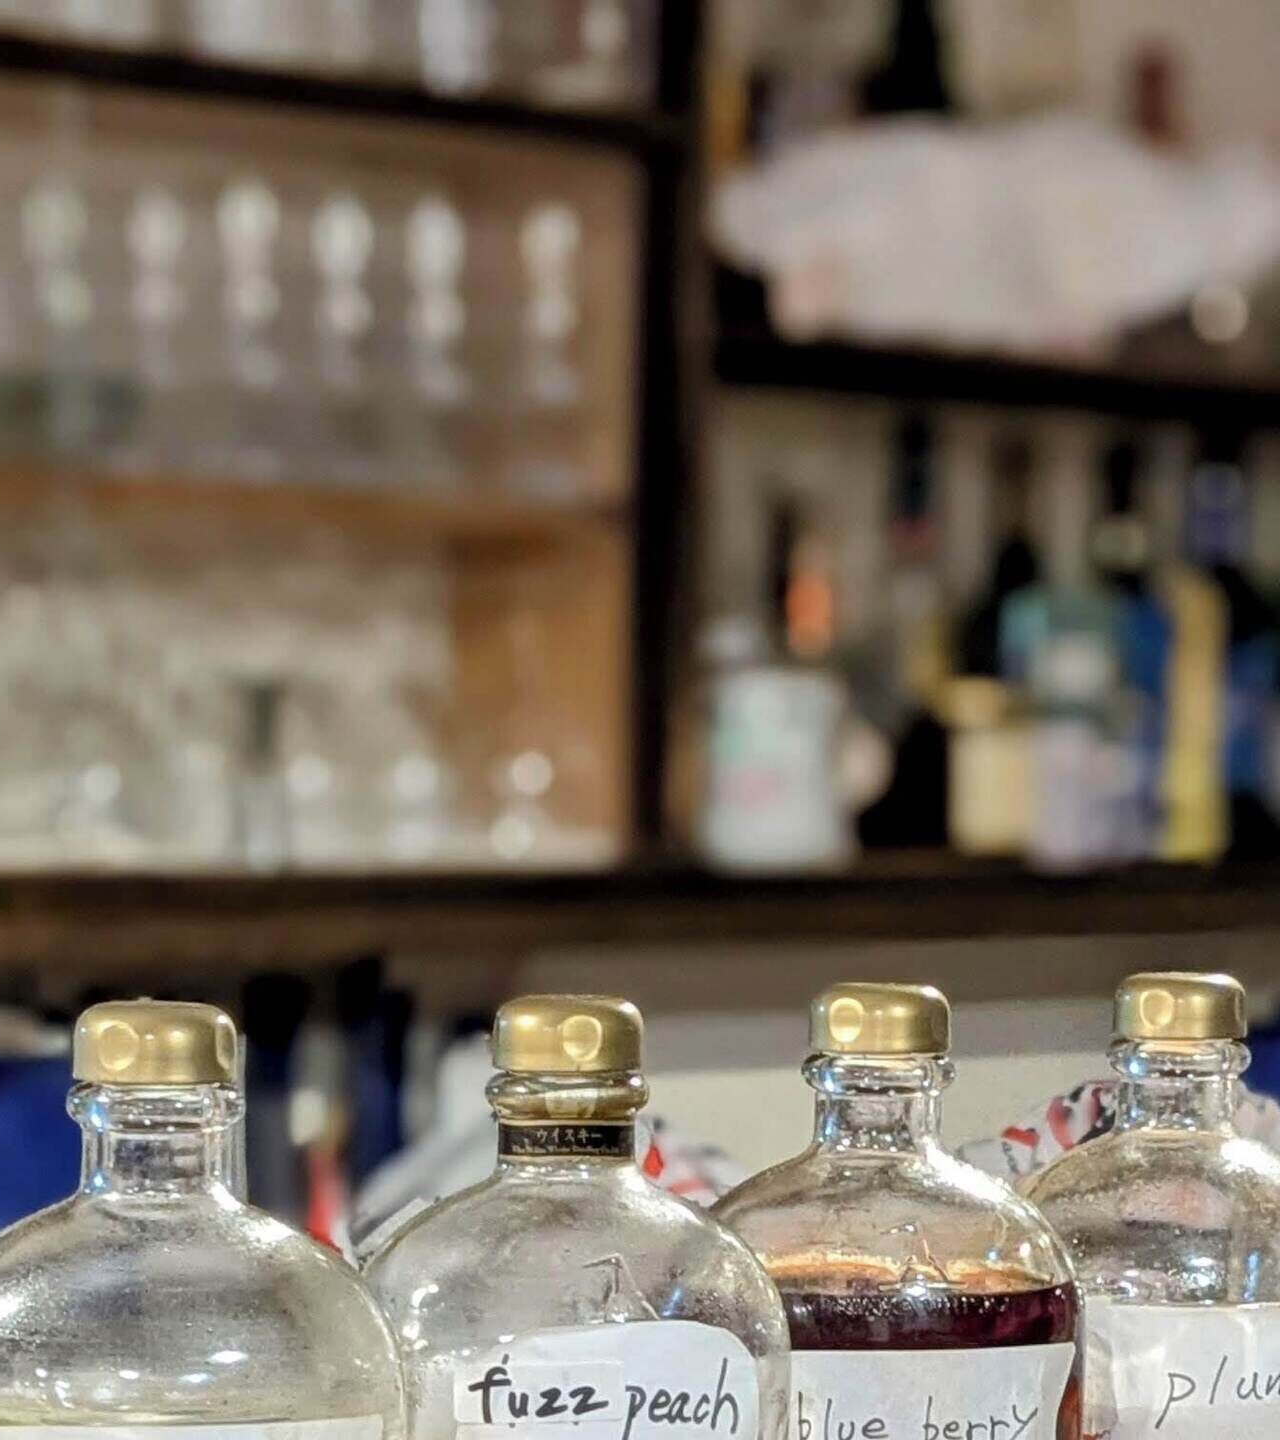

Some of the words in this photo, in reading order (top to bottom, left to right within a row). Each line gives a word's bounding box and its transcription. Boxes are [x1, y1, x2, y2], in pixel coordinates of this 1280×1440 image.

[536, 1127, 603, 1143] ウイスキー
[469, 1354, 609, 1428] fuzz
